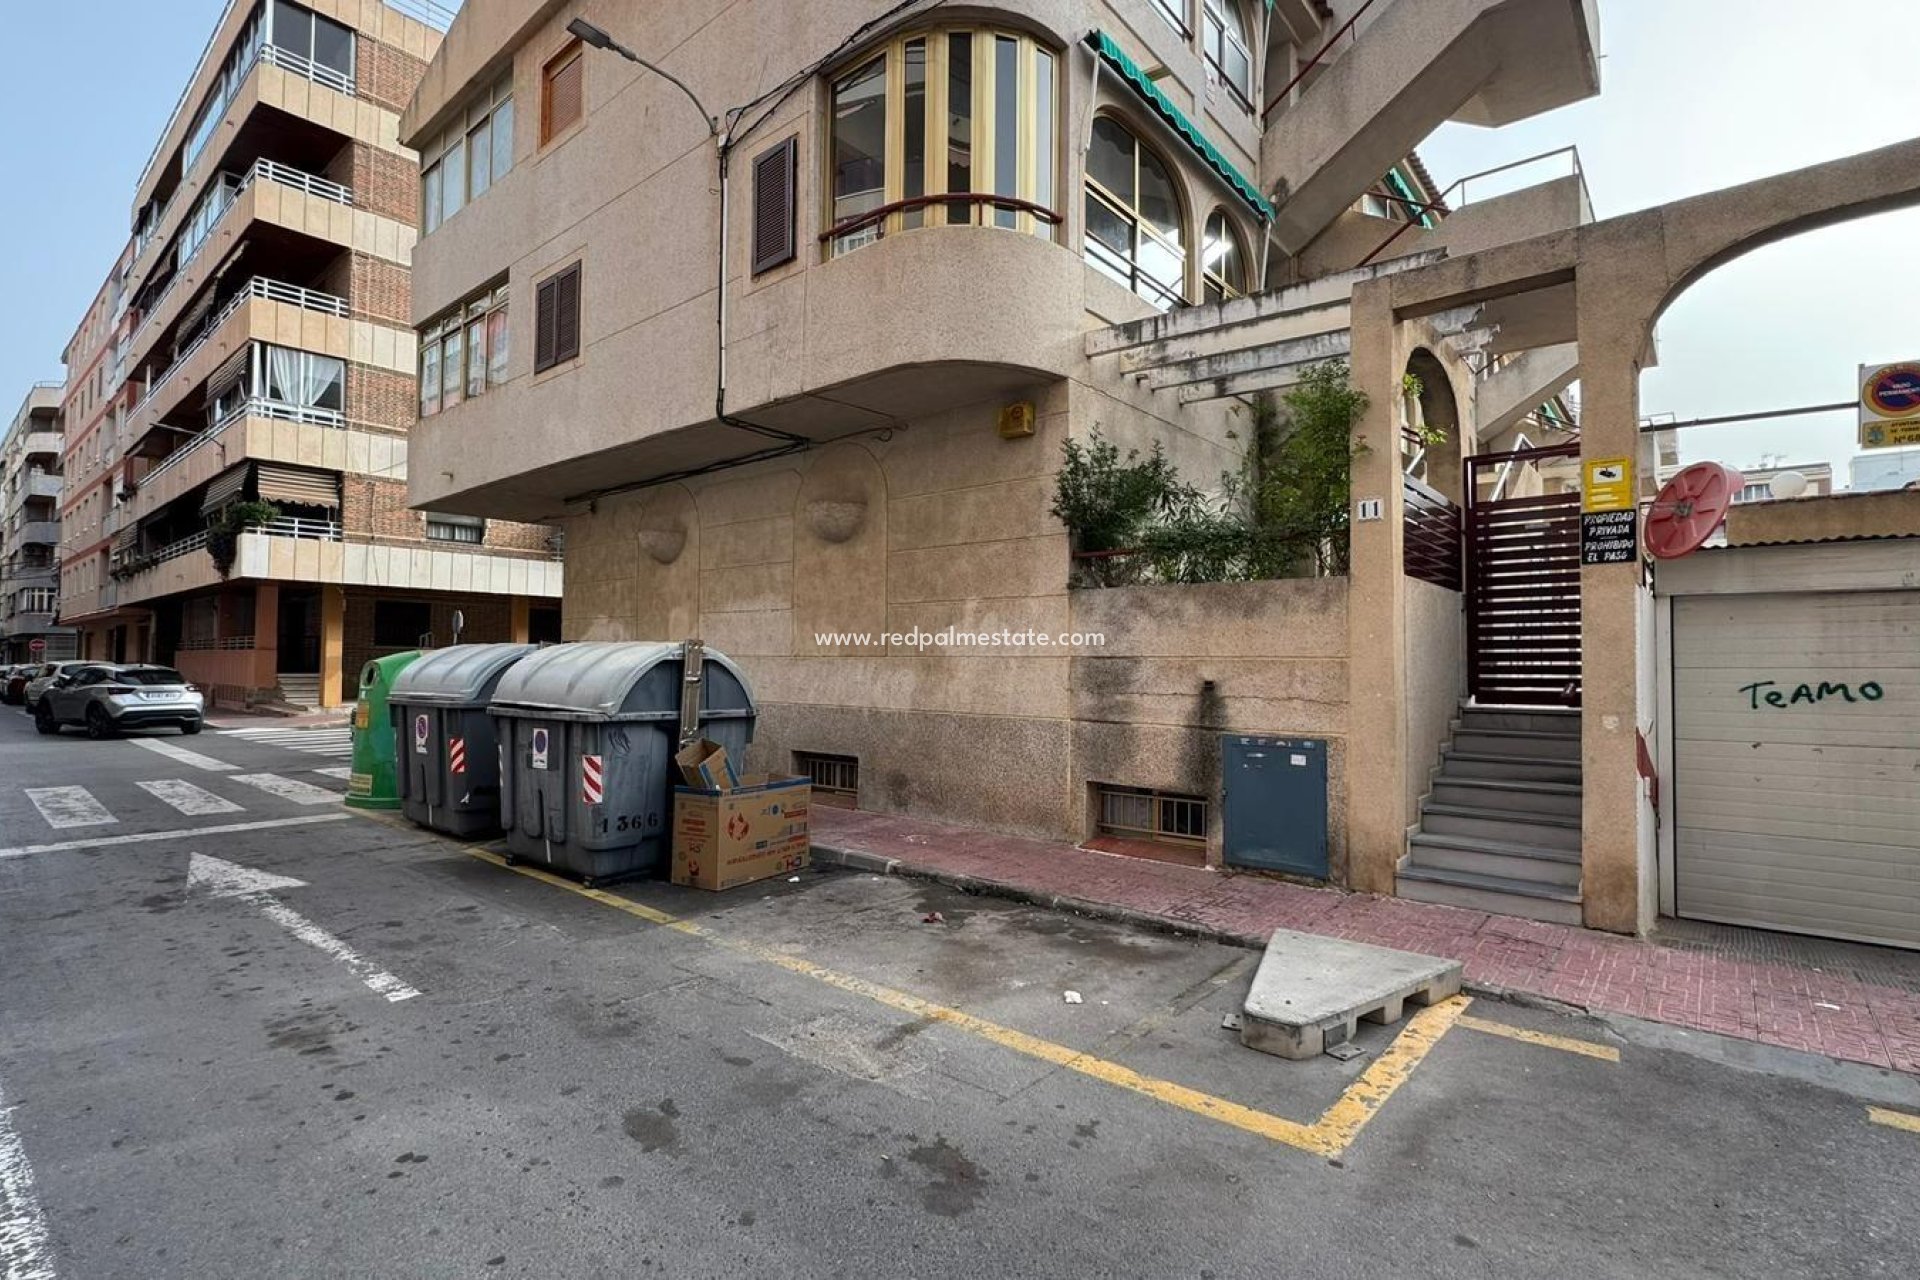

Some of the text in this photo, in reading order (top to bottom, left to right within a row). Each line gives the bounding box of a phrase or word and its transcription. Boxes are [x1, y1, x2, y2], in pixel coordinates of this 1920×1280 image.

[1362, 501, 1378, 518] 11
[1584, 512, 1634, 525] PROPIEDAD
[1588, 525, 1629, 536] PRIVADA
[1584, 539, 1634, 552] PROHIBIDO
[1587, 553, 1599, 562] EL
